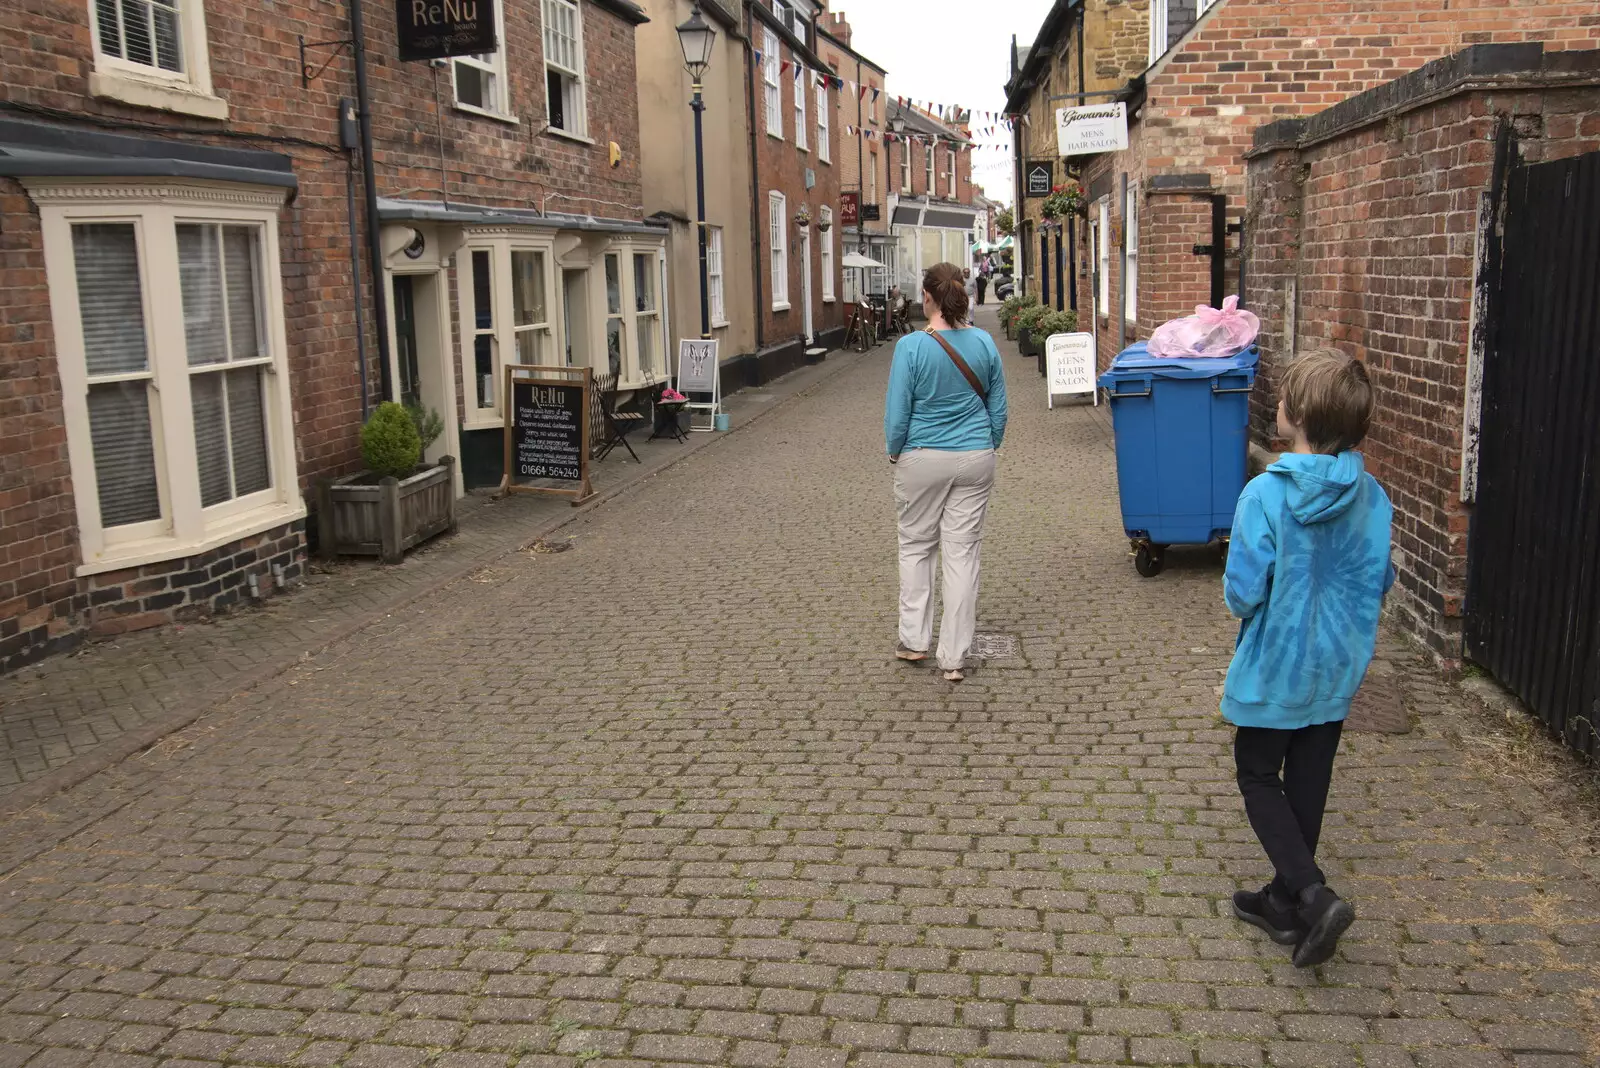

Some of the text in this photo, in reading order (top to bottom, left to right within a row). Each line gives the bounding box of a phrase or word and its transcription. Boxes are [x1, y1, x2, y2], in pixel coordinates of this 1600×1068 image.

[412, 0, 477, 27] ReNu
[454, 22, 477, 30] beauty
[1061, 107, 1120, 128] Giovanni's
[1081, 129, 1104, 139] MENS
[1068, 138, 1118, 151] HAIR SALON
[1057, 356, 1085, 365] MENS
[1058, 366, 1084, 376] HAIR
[1055, 376, 1089, 386] SALON
[521, 464, 578, 478] 01664 564240
